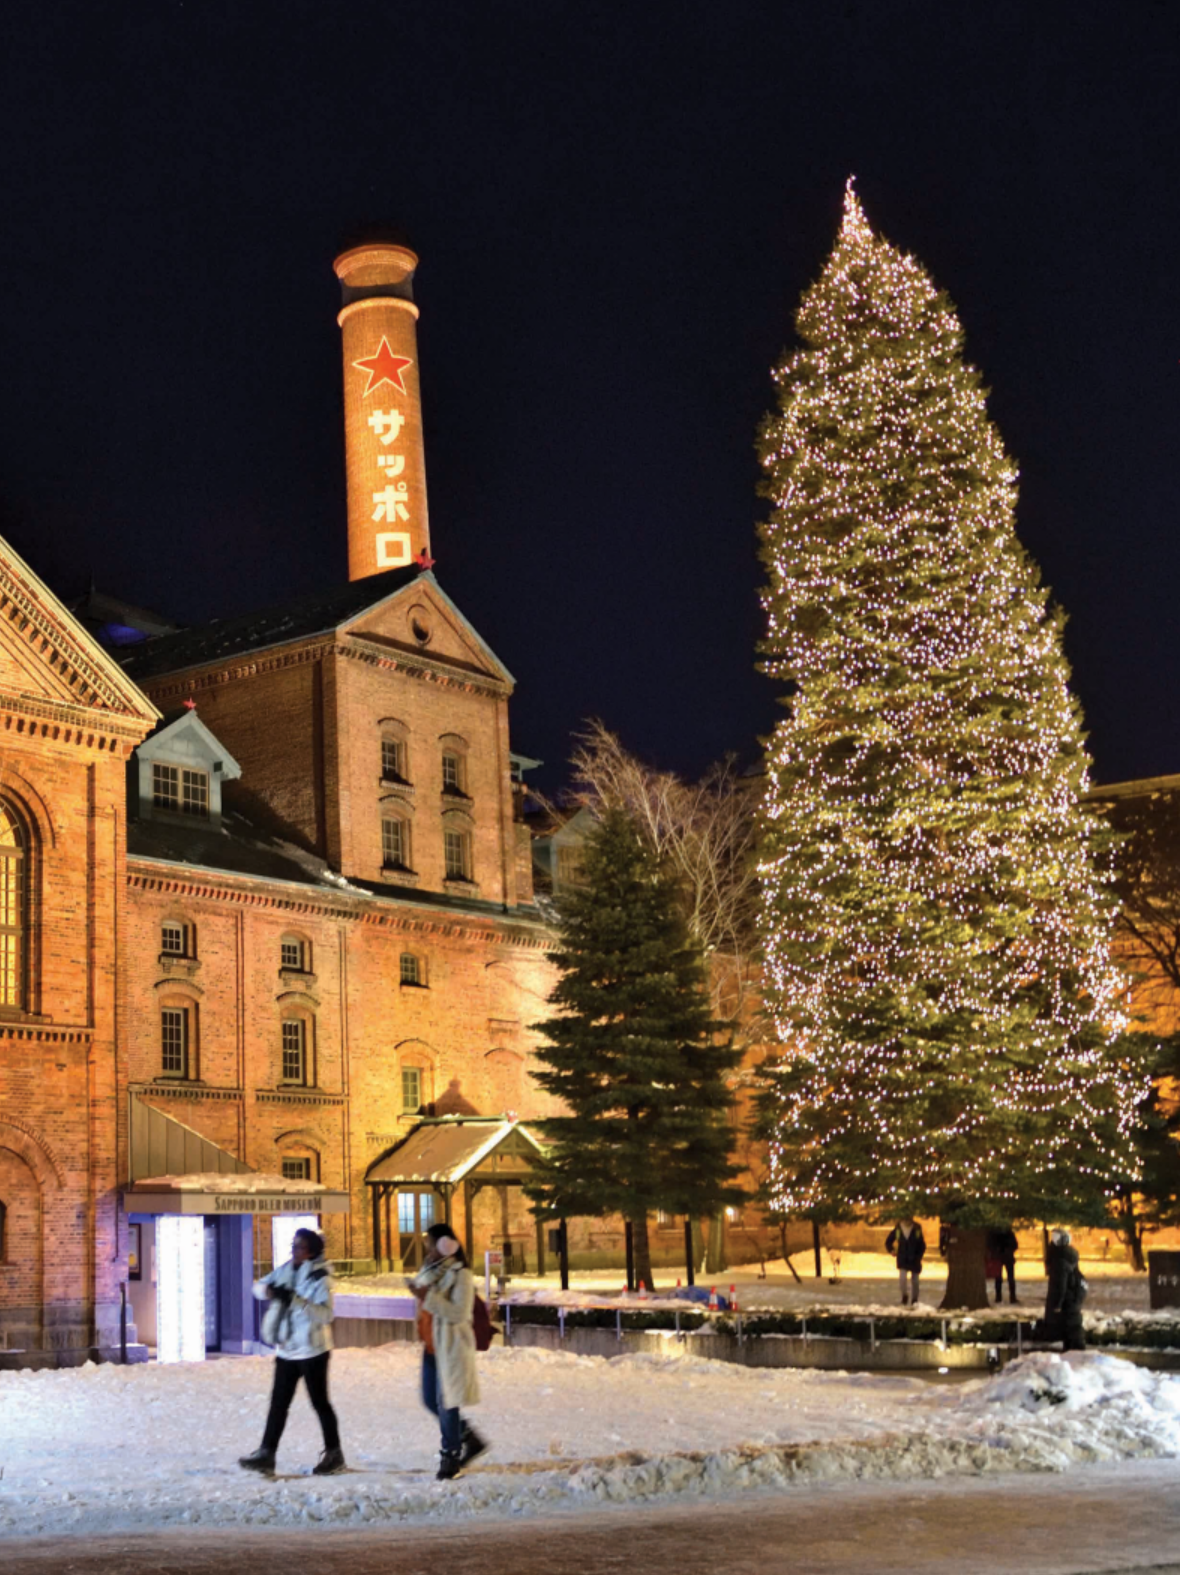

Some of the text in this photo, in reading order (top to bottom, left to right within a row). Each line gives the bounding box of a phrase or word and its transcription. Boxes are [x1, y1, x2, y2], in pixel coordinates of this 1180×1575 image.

[368, 409, 411, 567] サッポロ
[215, 1196, 322, 1211] SAPPORO BEER MUSEUM
